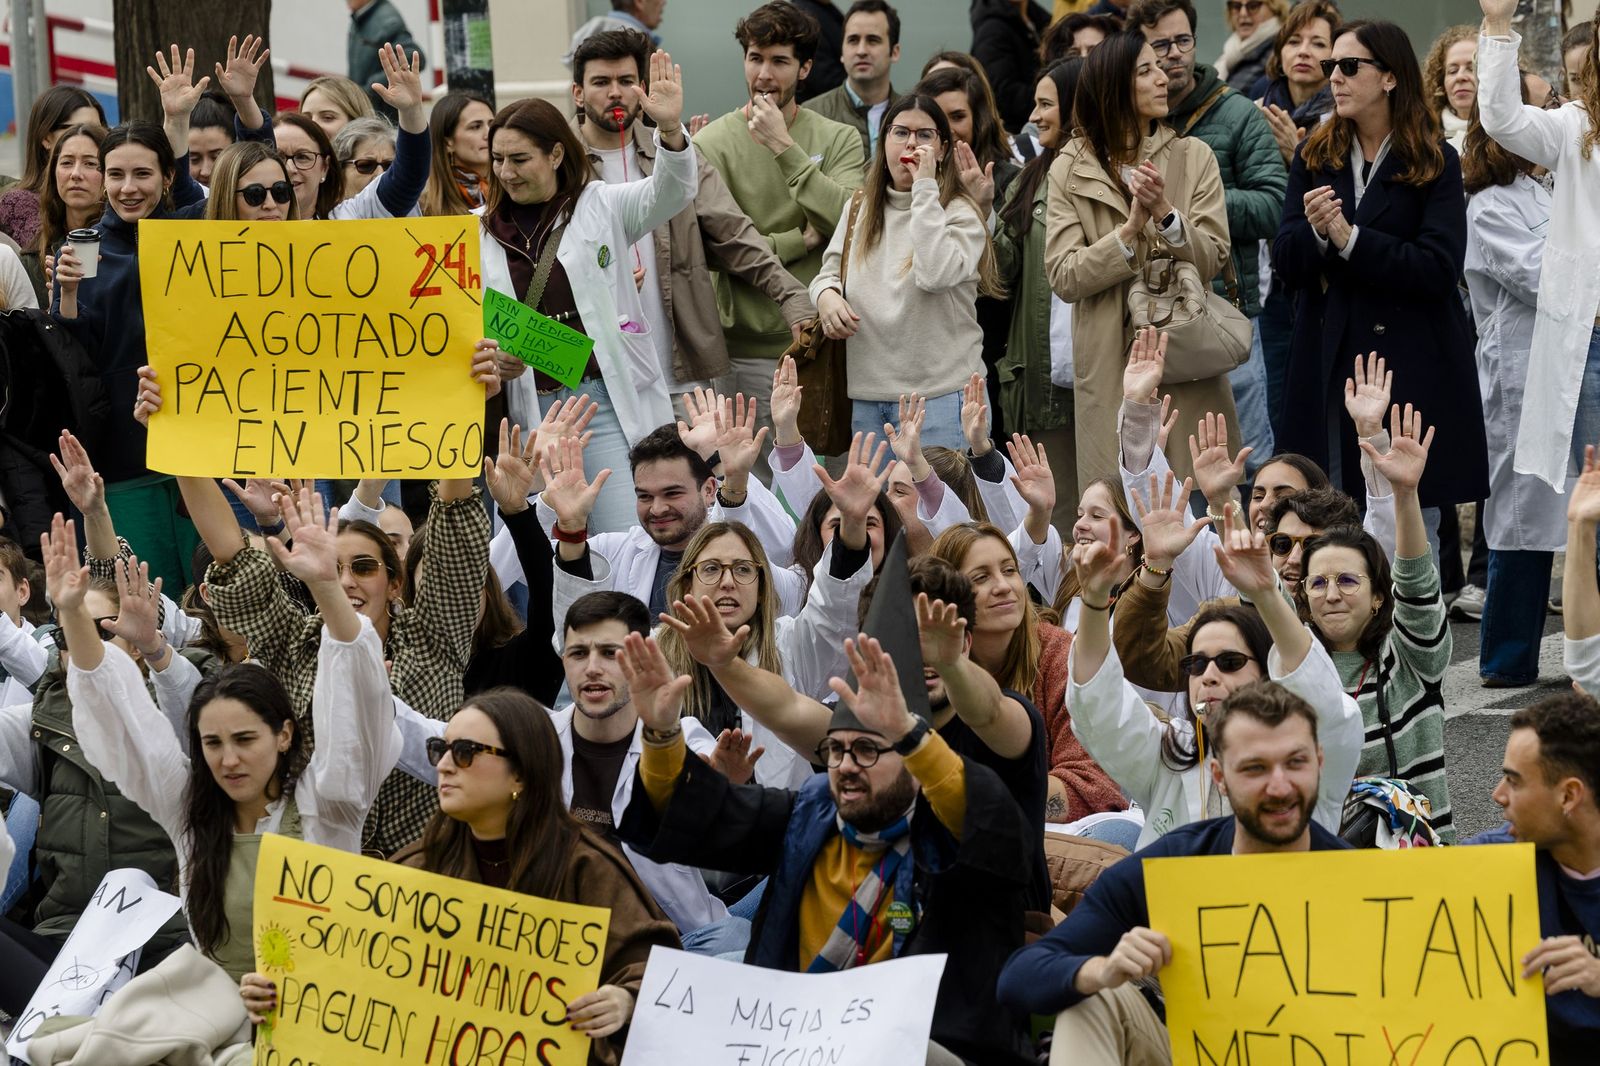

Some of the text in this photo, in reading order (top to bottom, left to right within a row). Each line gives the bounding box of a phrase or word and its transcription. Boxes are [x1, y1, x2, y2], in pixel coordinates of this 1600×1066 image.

[164, 226, 380, 299] MÉDICO
[215, 310, 450, 359] AGOTADO
[489, 311, 559, 353] NO HAY
[527, 316, 586, 347] MÉDICOS
[232, 418, 307, 475] EN
[279, 856, 603, 968] NO SOMOS HÉROES
[1197, 893, 1517, 1000] FALTAN
[300, 915, 572, 1026] SOMOS HUMANOS
[654, 967, 875, 1041] LA MAGIA ES
[280, 976, 417, 1059] PAGUEN
